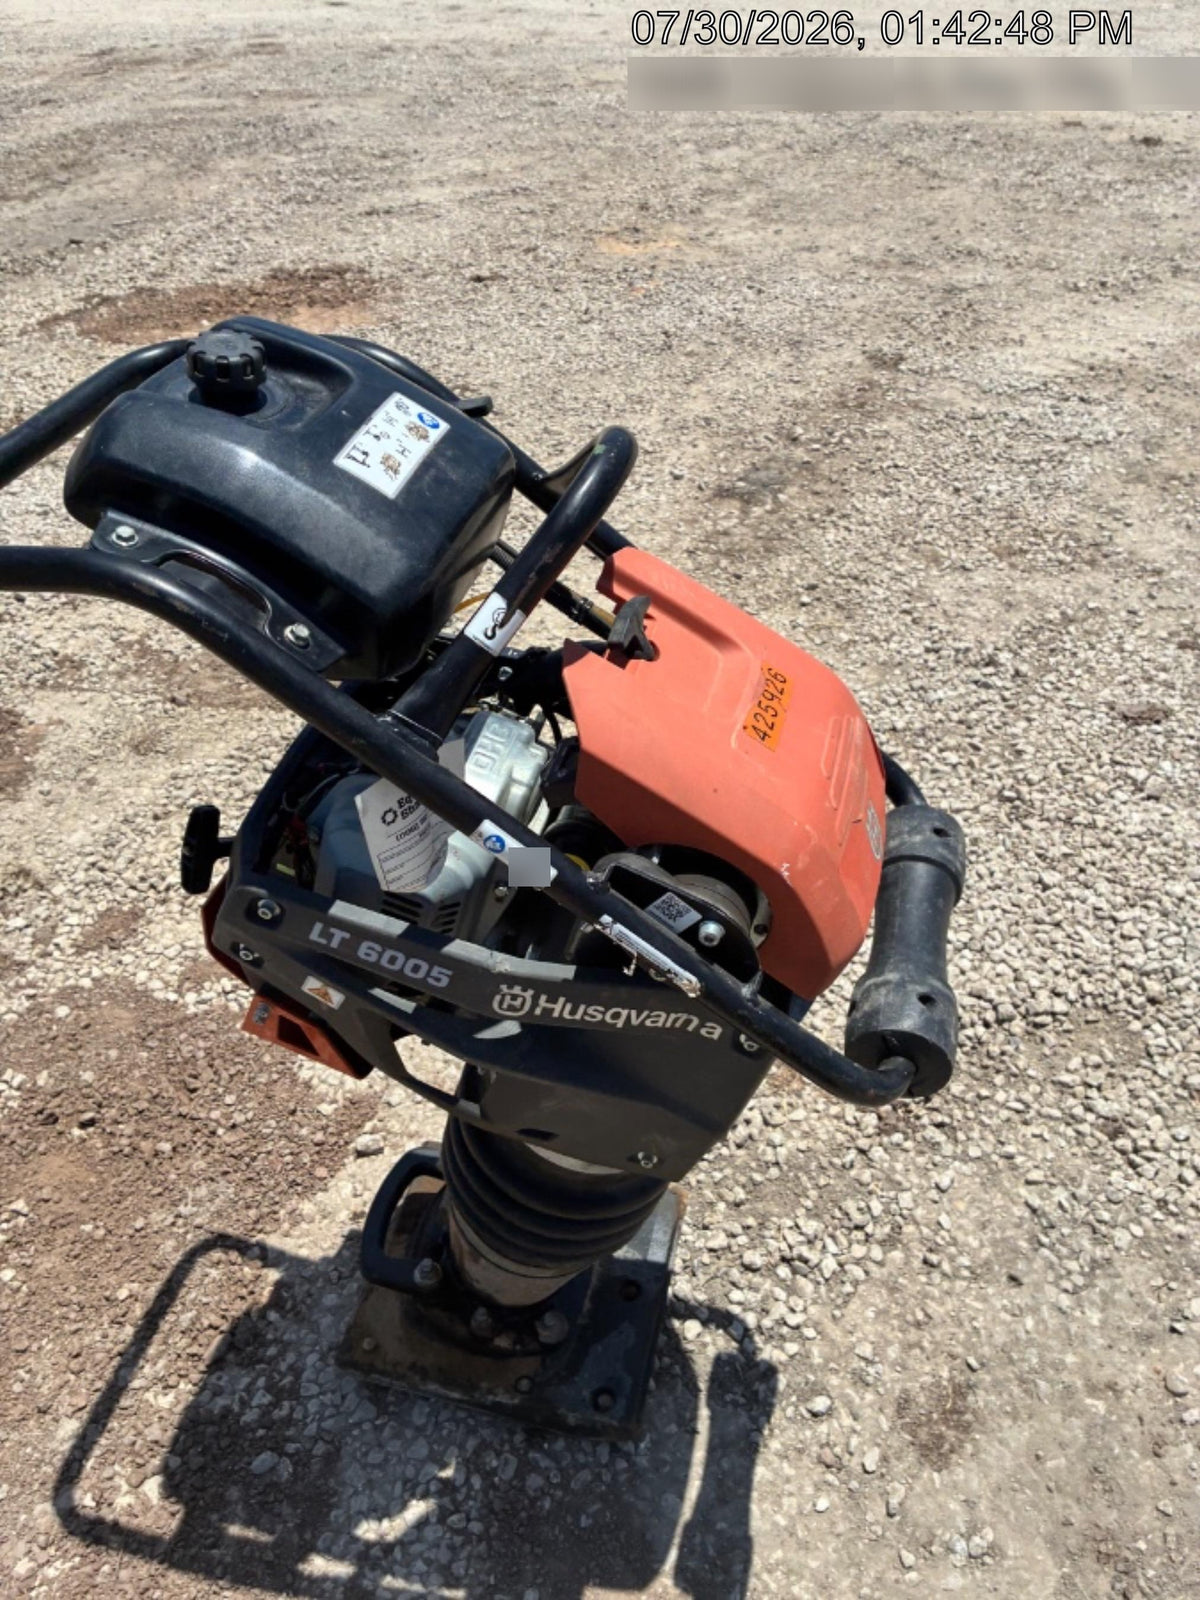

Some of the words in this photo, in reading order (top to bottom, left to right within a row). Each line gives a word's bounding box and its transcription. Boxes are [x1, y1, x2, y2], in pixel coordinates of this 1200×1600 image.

[309, 921, 351, 949] LT
[356, 941, 453, 988] 6005
[534, 993, 723, 1041] Husqvarna
